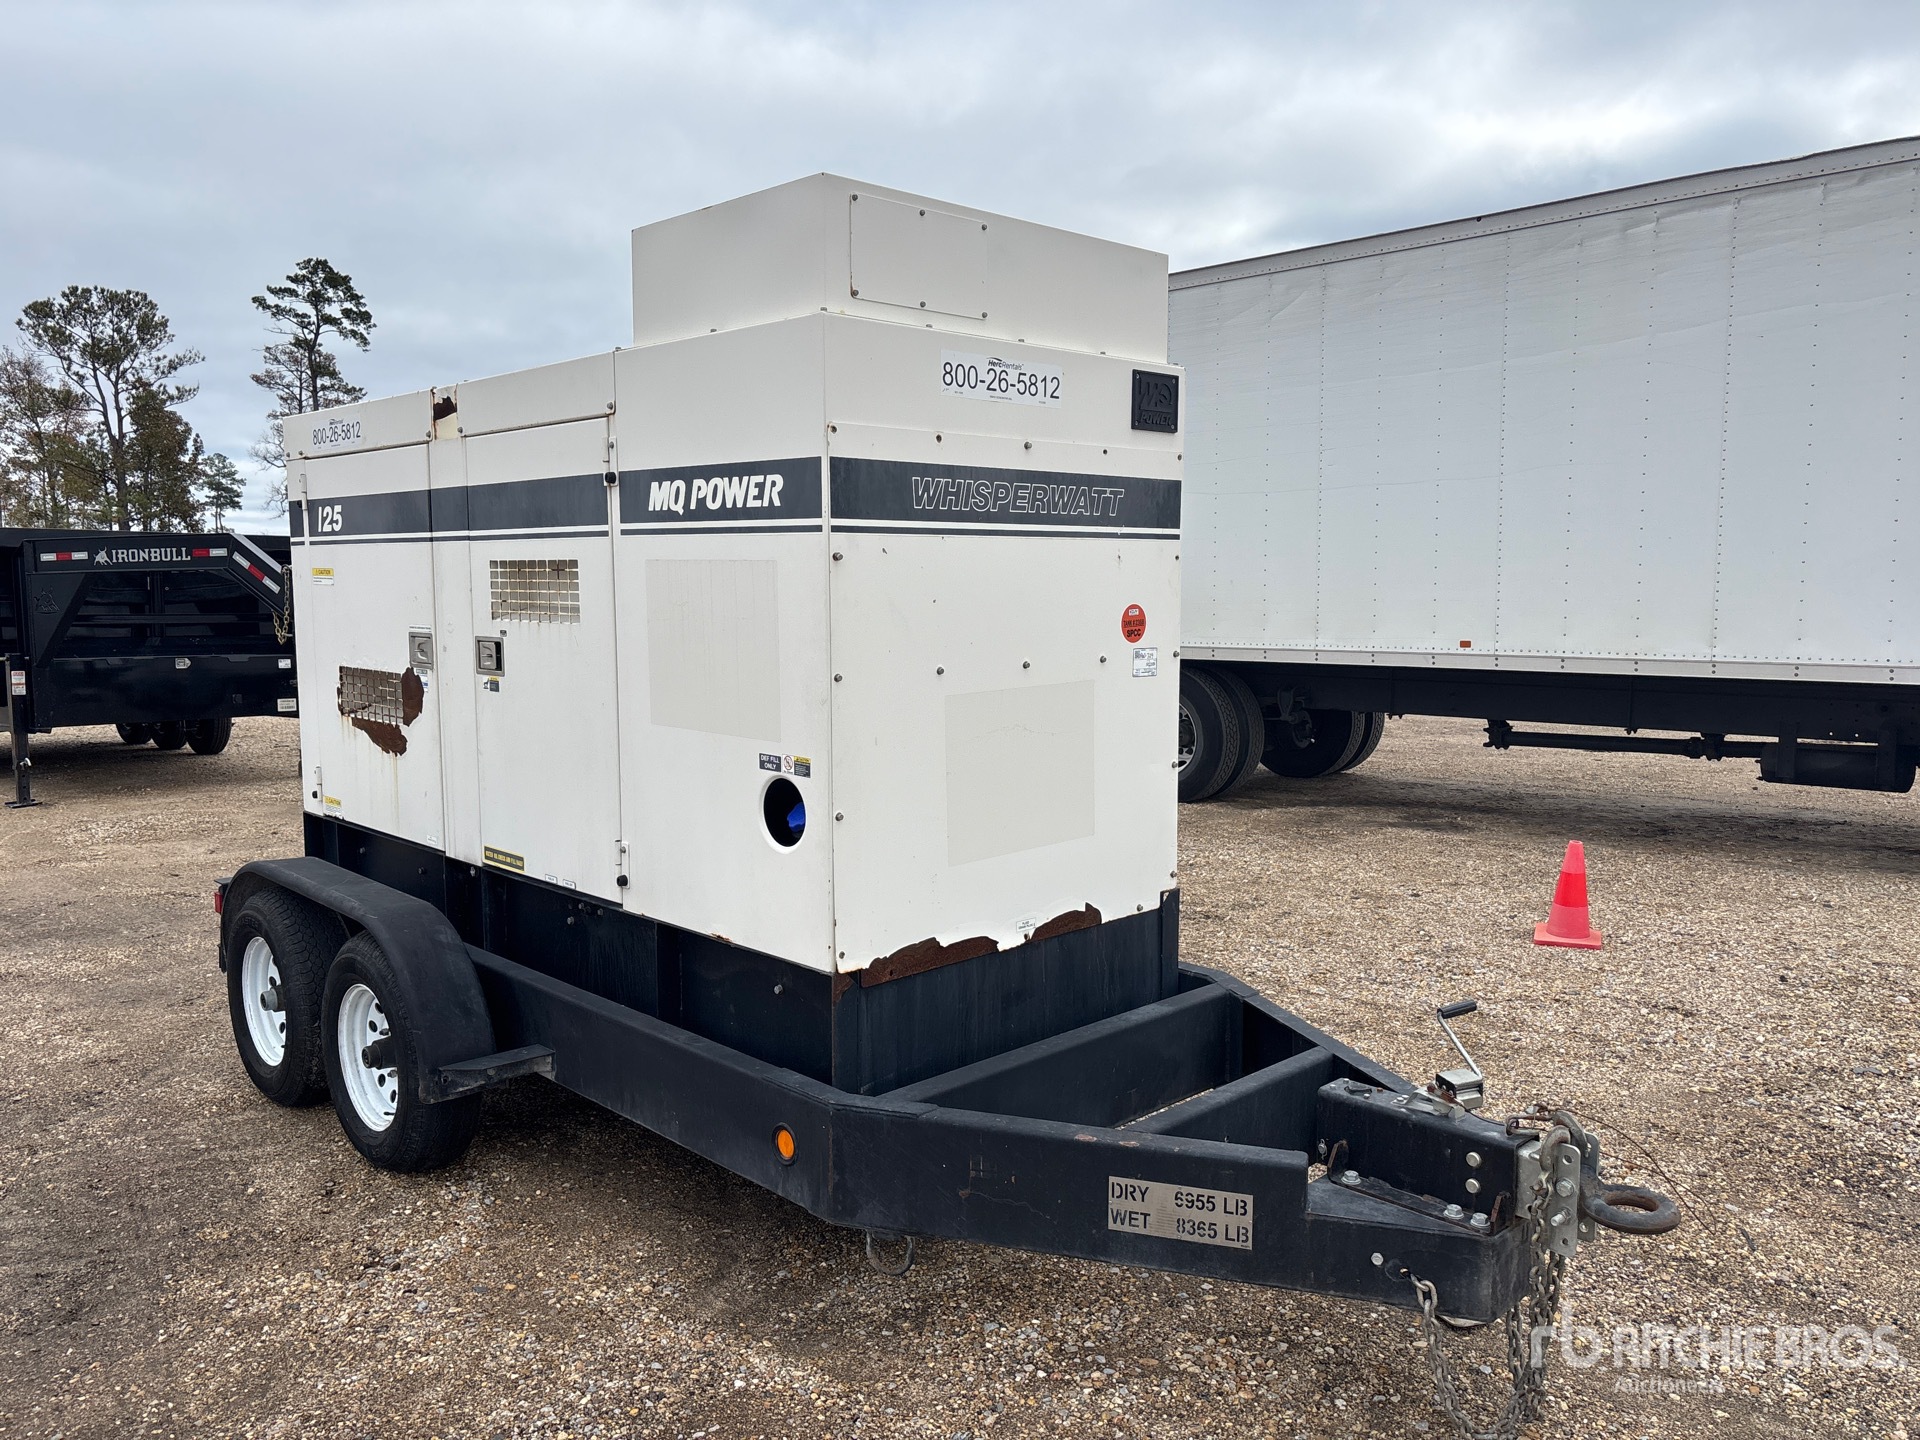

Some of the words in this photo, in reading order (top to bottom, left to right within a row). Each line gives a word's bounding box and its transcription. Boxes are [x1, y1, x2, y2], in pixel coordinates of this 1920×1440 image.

[942, 361, 1060, 400] 800-26-5812
[312, 421, 361, 445] 800-26-5812
[648, 479, 686, 516] MQ
[689, 473, 784, 510] POWER
[912, 476, 1125, 516] WHISPERWATT
[318, 504, 343, 533] 125
[111, 547, 191, 564] IRONBULL
[1126, 628, 1141, 638] SPCC
[770, 756, 780, 764] FILL
[1111, 1181, 1149, 1203] DRY
[1174, 1190, 1216, 1212] 6955
[1223, 1197, 1248, 1217] LB
[1110, 1207, 1150, 1229] WET
[1176, 1217, 1218, 1239] 8365
[1224, 1224, 1249, 1244] LB
